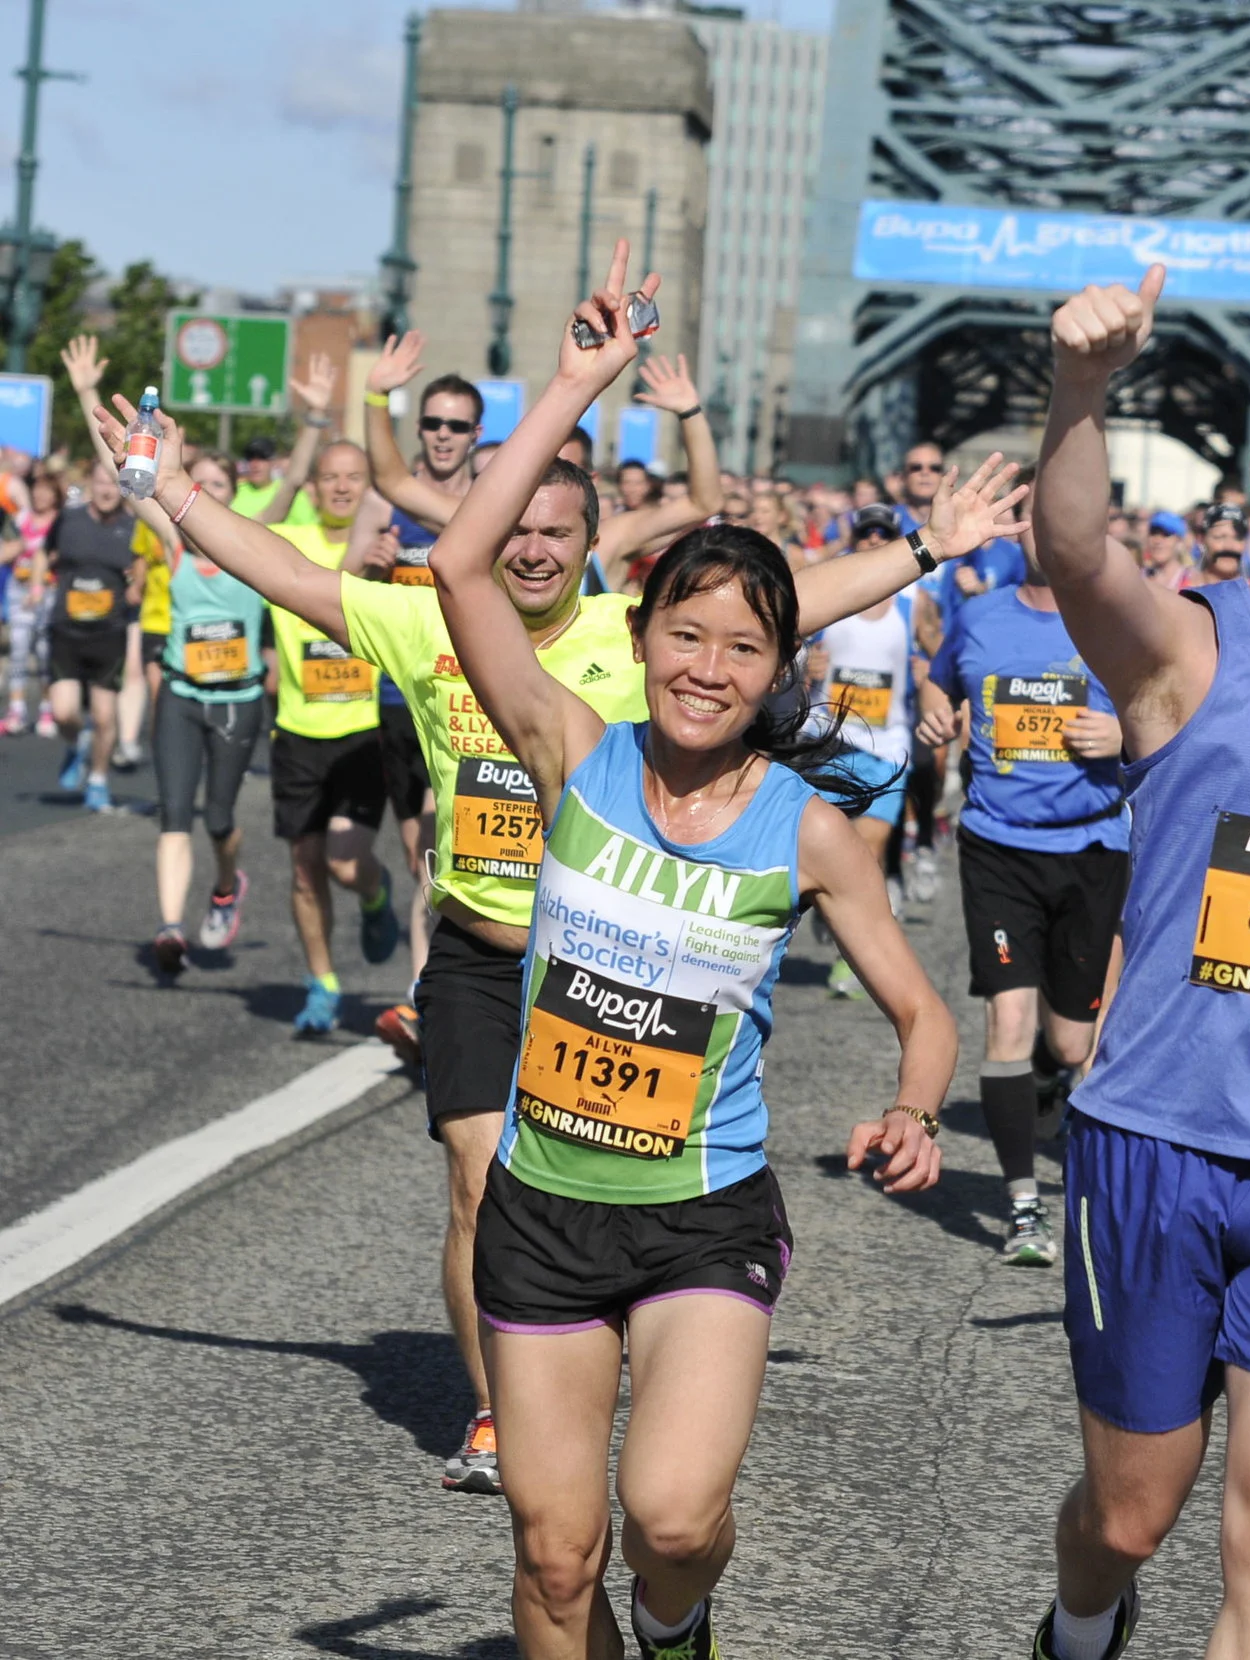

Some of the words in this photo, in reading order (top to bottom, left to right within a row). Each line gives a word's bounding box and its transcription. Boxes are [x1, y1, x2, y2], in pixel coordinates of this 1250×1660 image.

[873, 214, 979, 240] Bupa
[1035, 220, 1131, 248] great
[579, 671, 611, 685] adidas
[1009, 677, 1060, 701] Bupa
[449, 716, 464, 732] &
[468, 717, 496, 734] LY
[1016, 715, 1064, 733] 6572
[500, 848, 525, 858] PUMA
[583, 833, 742, 919] AILYN
[539, 886, 670, 959] Alzheimer's
[688, 921, 742, 947] Leading
[742, 933, 760, 948] the
[561, 929, 665, 987] Society
[684, 935, 720, 958] fight
[720, 947, 761, 964] against
[680, 951, 742, 977] dementia
[566, 970, 660, 1028] Bupa
[553, 1040, 661, 1099] 11391
[576, 1096, 611, 1116] PUMA
[520, 1095, 675, 1157] #GNRMILLION
[670, 1118, 681, 1131] D
[746, 1270, 769, 1289] RUN
